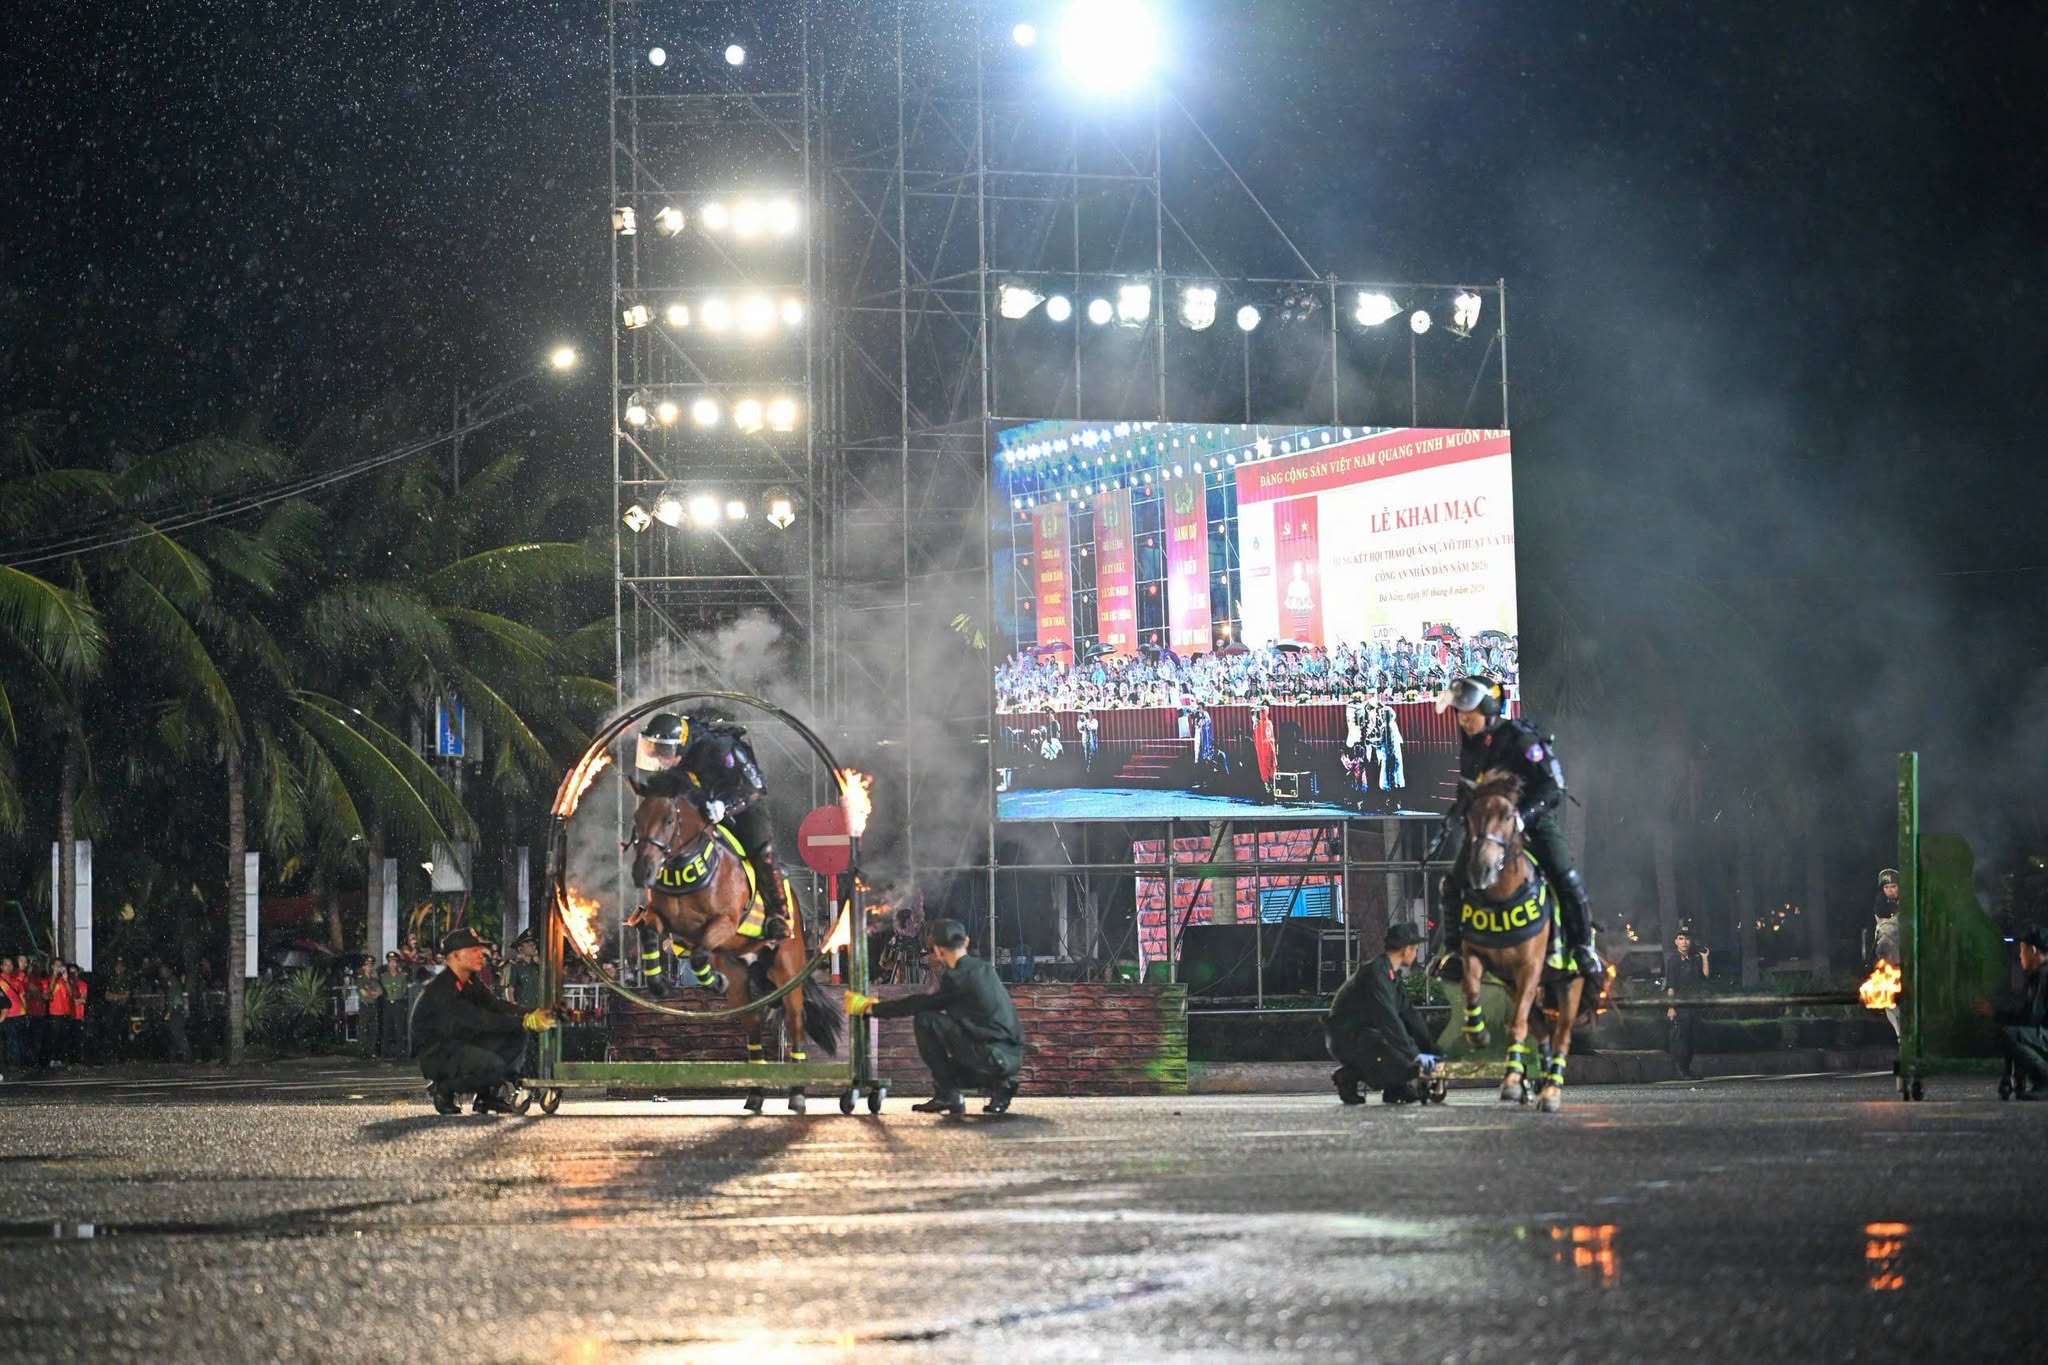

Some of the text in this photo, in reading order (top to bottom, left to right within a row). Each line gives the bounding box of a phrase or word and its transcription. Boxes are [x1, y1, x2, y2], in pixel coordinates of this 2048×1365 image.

[1260, 471, 1283, 487] ĐẢNG
[1285, 465, 1308, 484] CỘNG
[1310, 461, 1328, 477] SẢN
[1330, 456, 1351, 475] VIỆT
[1353, 452, 1376, 470] NAM
[1378, 443, 1413, 465] QUANG
[1415, 437, 1443, 454] VINH
[1445, 429, 1481, 449] MUÔN
[1396, 503, 1439, 530] KHAI
[1444, 495, 1486, 525] MẠC
[656, 852, 707, 886] LICE
[1461, 898, 1541, 932] POLICE
